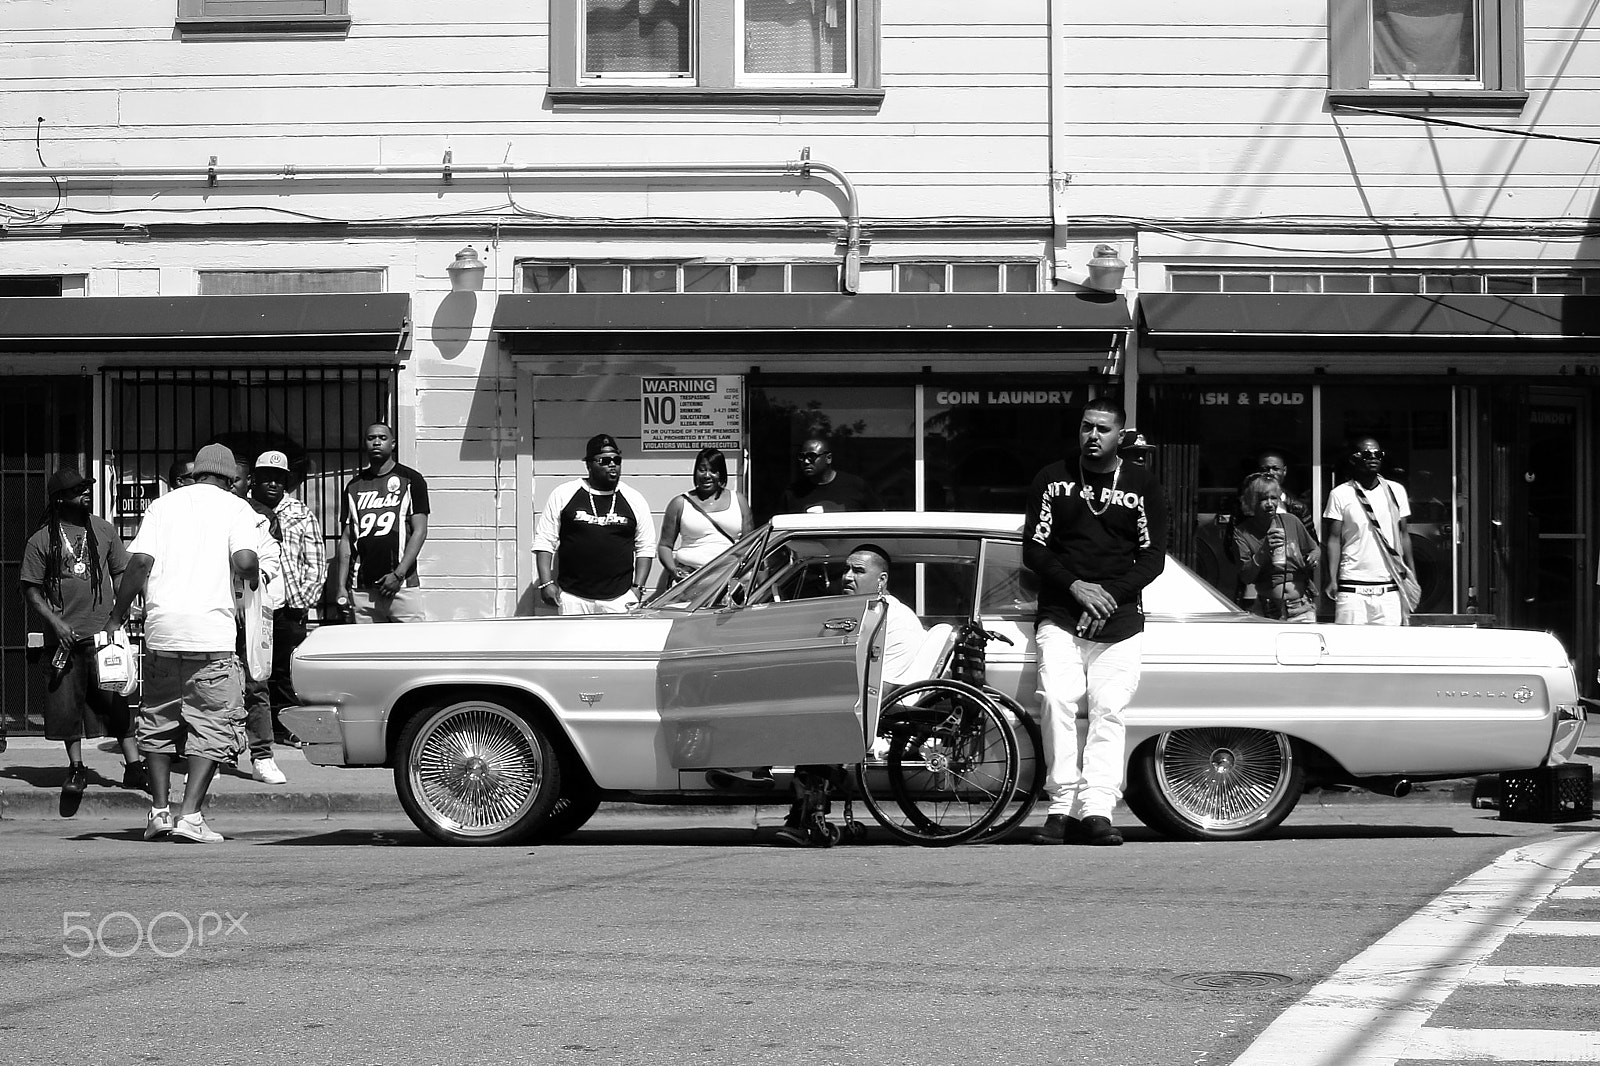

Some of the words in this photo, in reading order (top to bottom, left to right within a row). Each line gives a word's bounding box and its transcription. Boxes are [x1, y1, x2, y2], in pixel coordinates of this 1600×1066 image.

[644, 380, 715, 392] WARNING
[936, 391, 979, 404] COIN
[988, 391, 1073, 404] LAUNDRY
[1200, 392, 1229, 405] SH
[1237, 392, 1250, 405] &
[1258, 392, 1304, 405] FOLD
[643, 396, 676, 424] NO
[1080, 485, 1095, 500] &
[359, 511, 396, 538] 99
[1436, 690, 1507, 698] IMPALA
